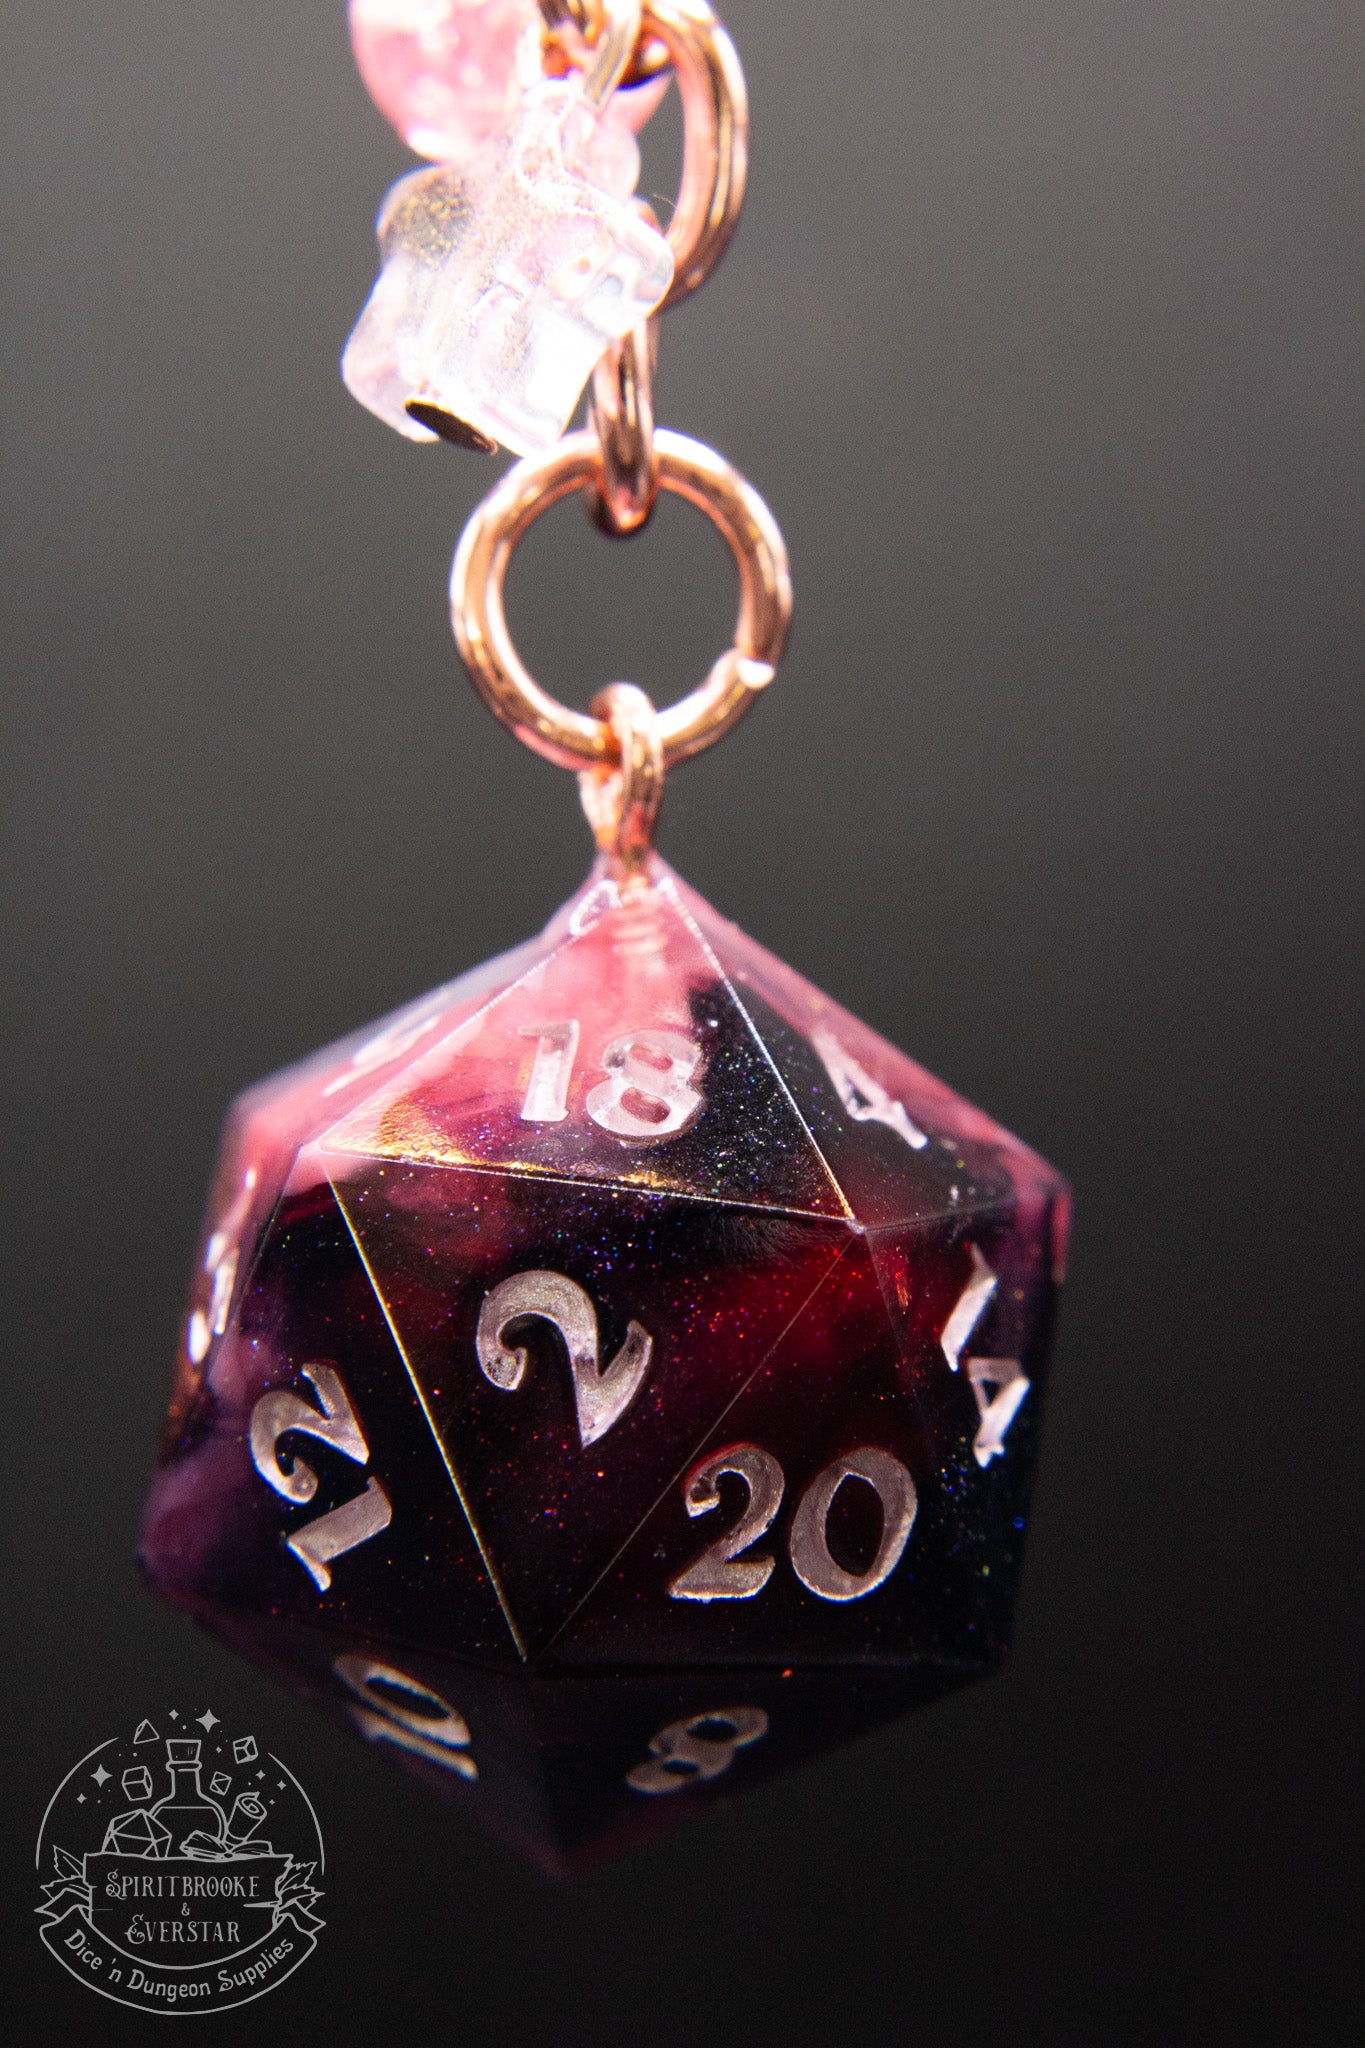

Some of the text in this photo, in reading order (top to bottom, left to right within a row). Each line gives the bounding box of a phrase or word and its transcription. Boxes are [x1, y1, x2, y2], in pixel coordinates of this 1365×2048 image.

[519, 1020, 705, 1143] 18
[812, 1031, 928, 1149] 4
[475, 1270, 654, 1449] 2
[249, 1362, 394, 1592] 12
[668, 1441, 919, 1602] 20
[625, 1705, 769, 1794] 8
